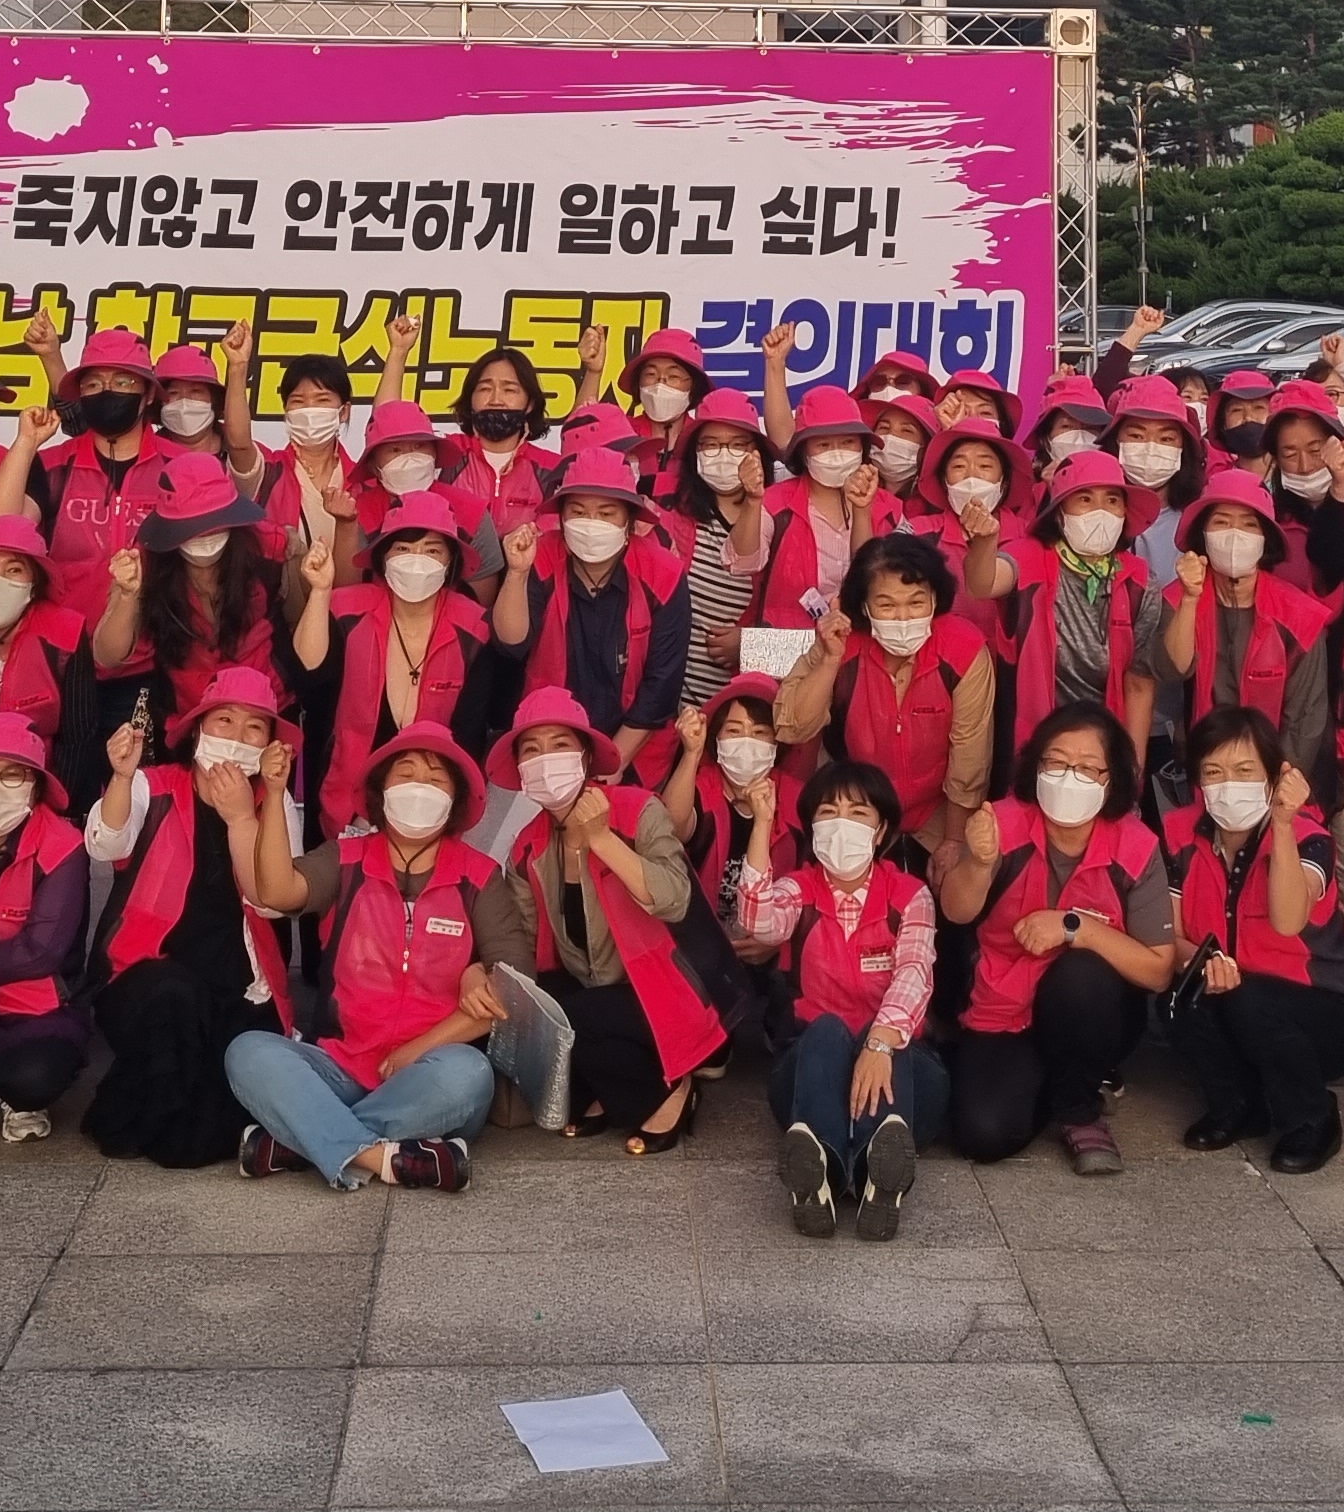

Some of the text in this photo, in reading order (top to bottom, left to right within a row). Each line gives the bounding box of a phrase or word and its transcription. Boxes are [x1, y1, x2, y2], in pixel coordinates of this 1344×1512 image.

[12, 174, 901, 258] 죽지않고 안전하게 일하고 싶다!
